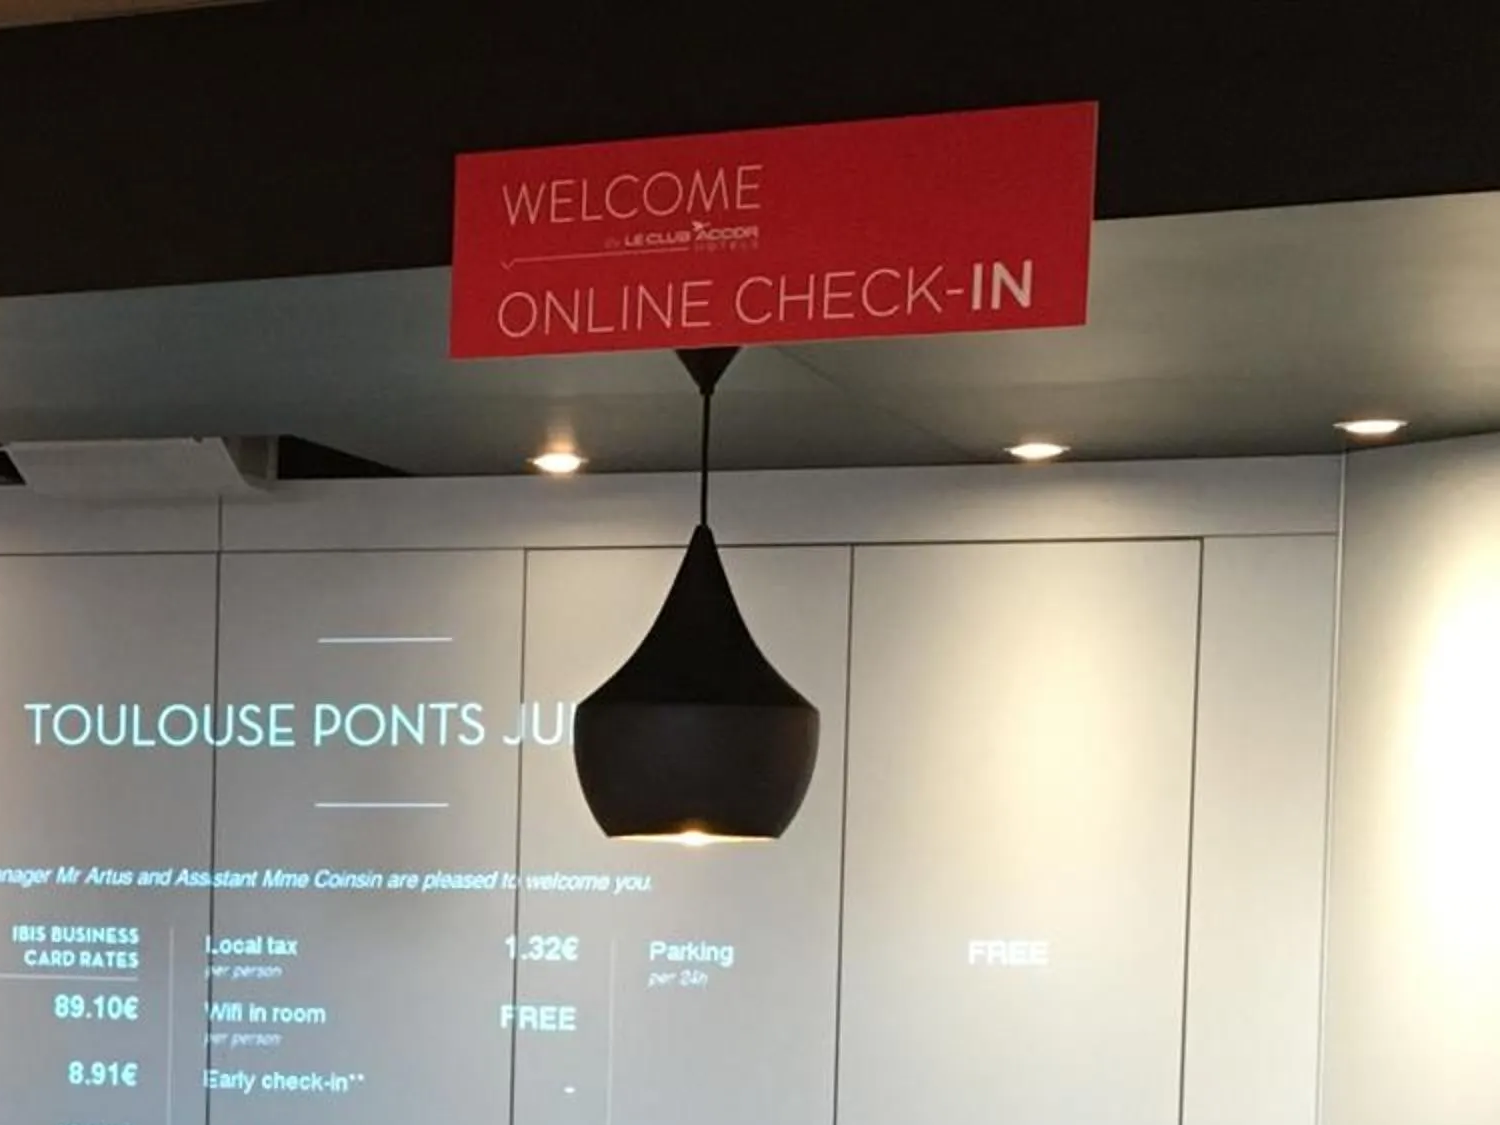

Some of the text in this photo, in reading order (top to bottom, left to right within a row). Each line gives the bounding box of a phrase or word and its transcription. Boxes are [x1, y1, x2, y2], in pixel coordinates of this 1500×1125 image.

[502, 165, 764, 226] WELCOME
[646, 230, 691, 245] CLUB
[497, 260, 1034, 338] ONLINE CHECK-IN
[24, 703, 577, 747] TOULOUSE PONTS JU
[55, 866, 82, 884] Mr
[84, 867, 134, 886] Artus
[137, 867, 171, 887] and
[262, 869, 307, 889] Mme
[313, 869, 383, 890] Coinsin
[387, 873, 420, 890] are
[422, 870, 498, 893] pleased
[525, 872, 611, 893] welcome
[12, 925, 140, 945] IBIS BUSINESS
[205, 935, 299, 956] Local tax
[504, 934, 580, 961] 1.32€
[24, 949, 140, 969] CARD RATES
[649, 941, 735, 968] Parking
[968, 940, 1051, 966] FREE
[231, 965, 283, 981] person
[54, 994, 140, 1021] 89.10€
[204, 1001, 327, 1025] Wifi in room
[500, 1004, 578, 1032] FREE
[68, 1060, 139, 1087] 8.91€
[203, 1069, 256, 1095] Early
